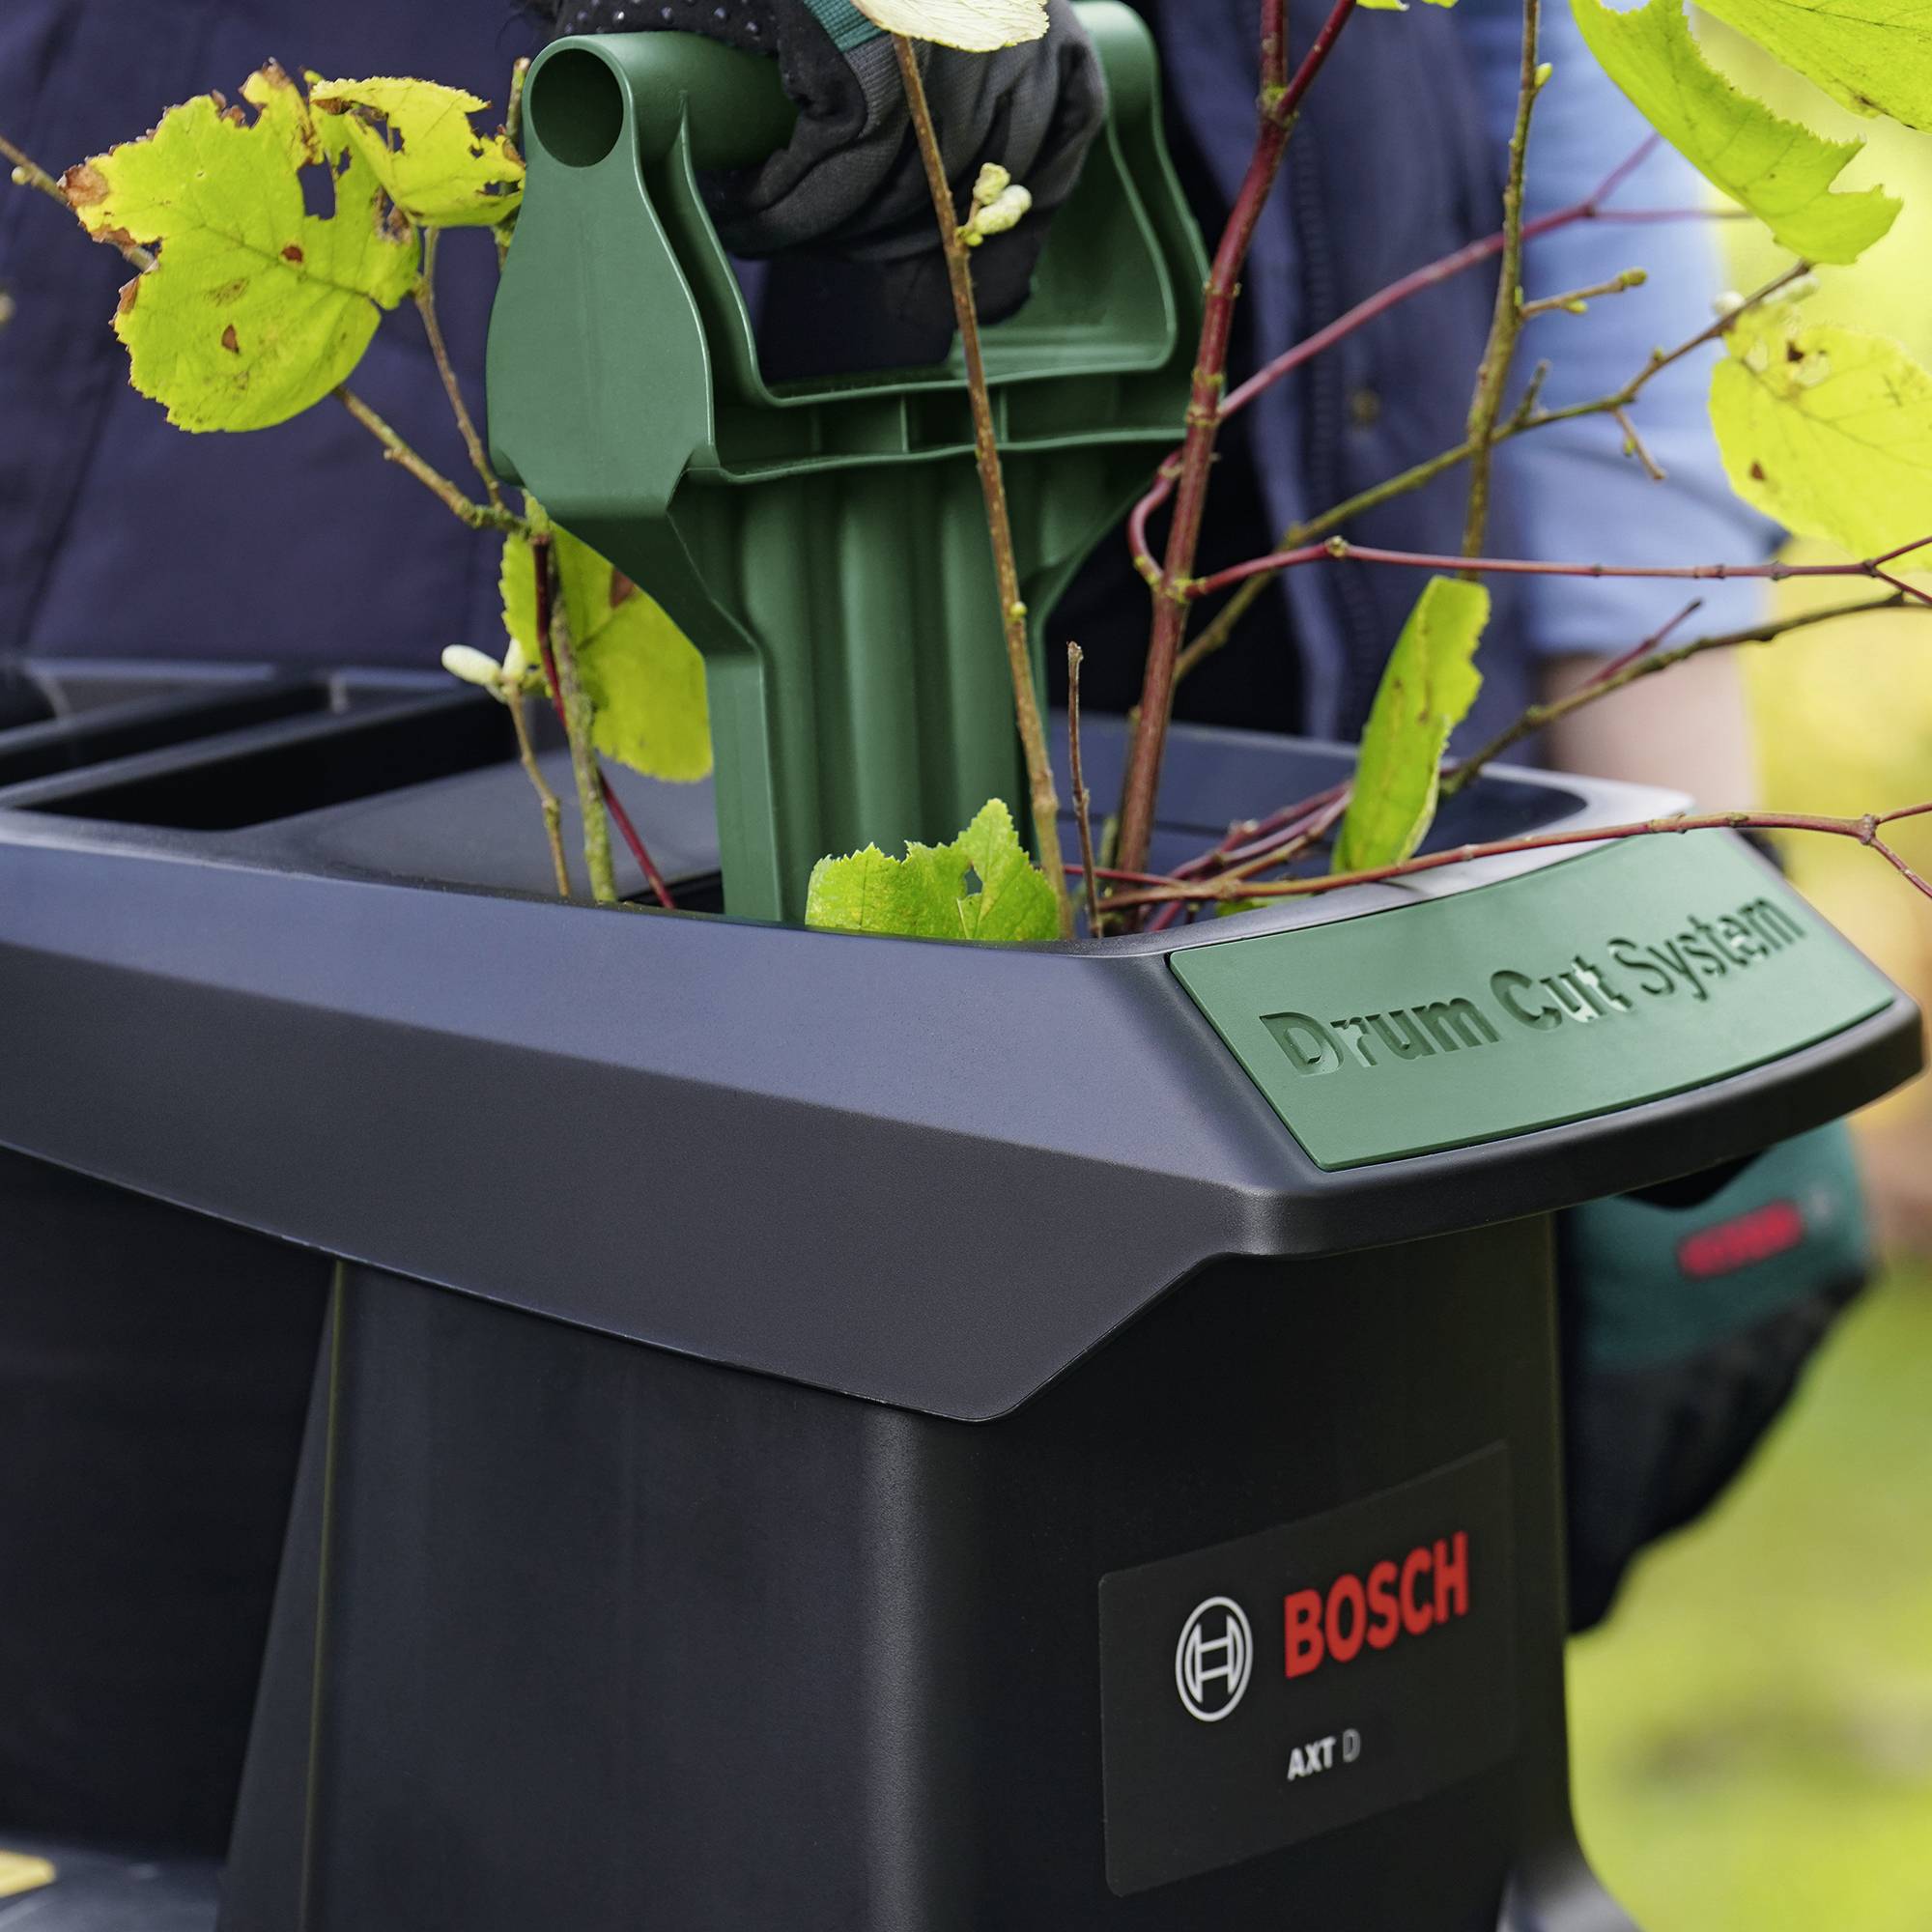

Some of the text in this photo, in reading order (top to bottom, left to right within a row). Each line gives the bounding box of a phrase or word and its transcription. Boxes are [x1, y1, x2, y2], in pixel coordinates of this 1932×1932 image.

[1260, 895, 1807, 1076] Drum Cut System
[1283, 1531, 1469, 1679] BOSCH
[1287, 1728, 1362, 1781] AXT D
